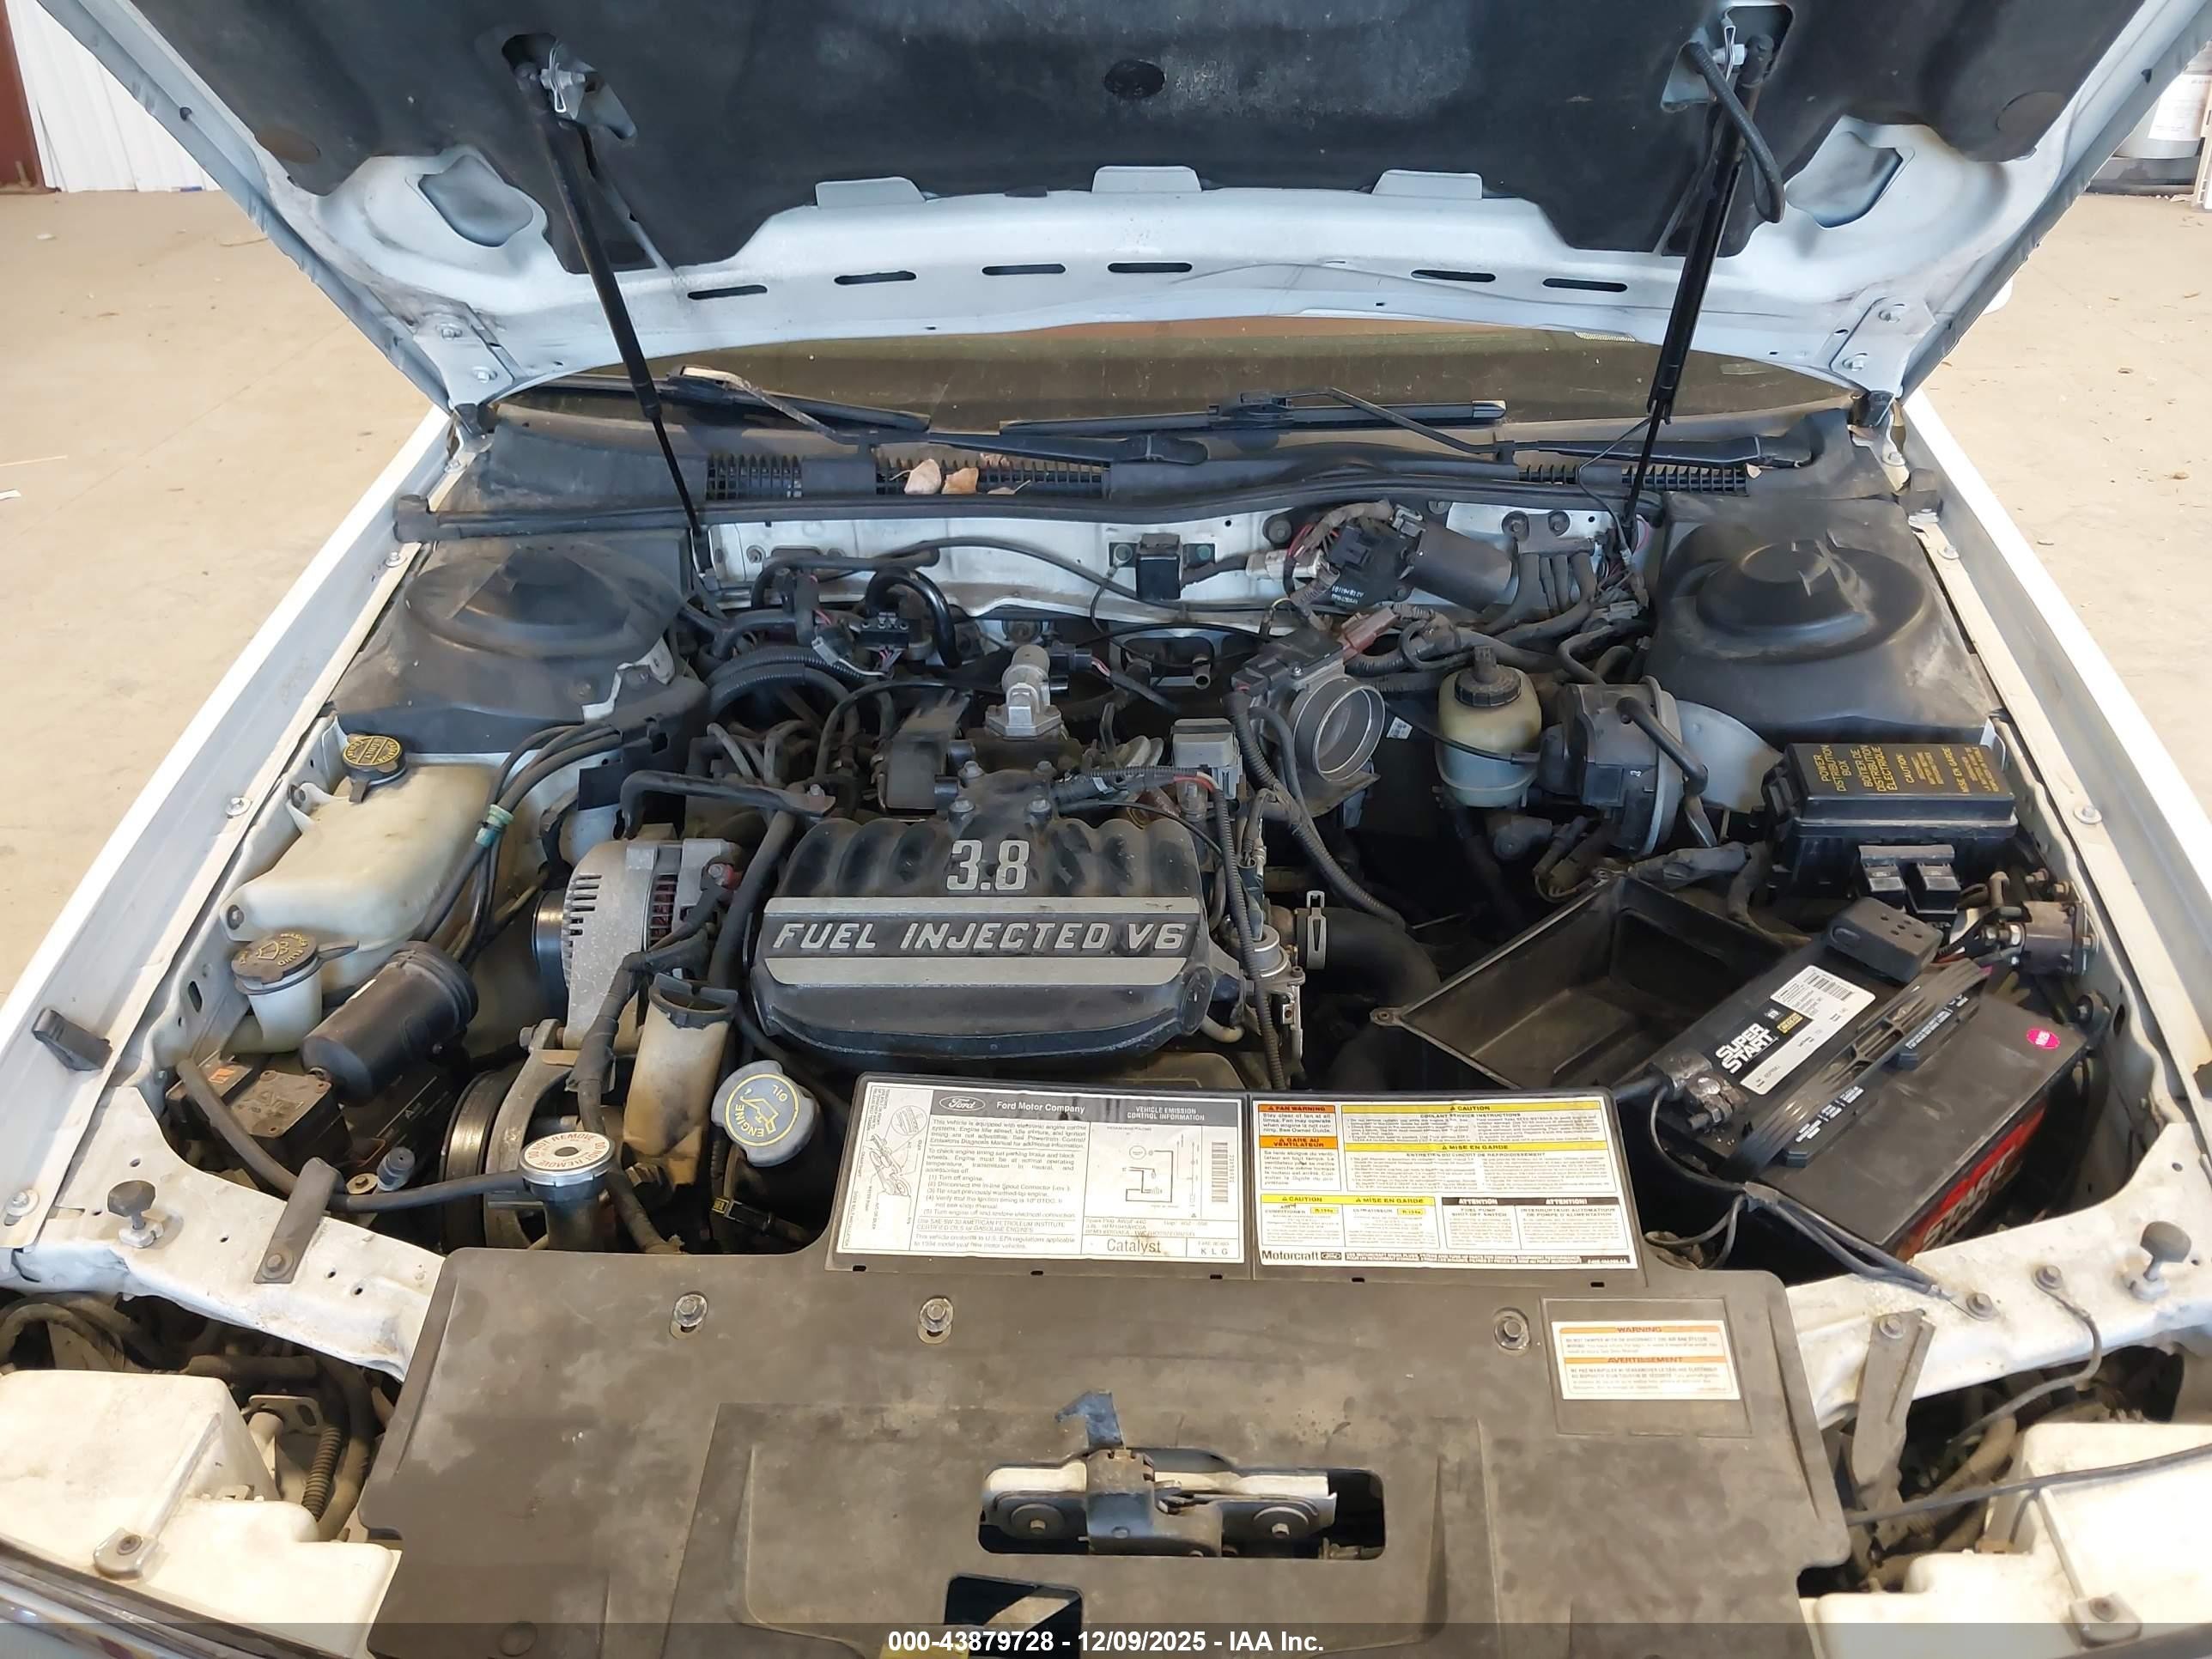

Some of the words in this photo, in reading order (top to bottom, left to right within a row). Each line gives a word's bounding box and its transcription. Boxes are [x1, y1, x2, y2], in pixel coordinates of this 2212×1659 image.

[1813, 754, 1832, 782] POWER
[1820, 744, 1847, 793] DISTRIBUTION
[1838, 759, 1852, 777] BOX
[1861, 744, 1887, 793] DISTRIBUTION
[945, 839, 1030, 891] 3.8
[772, 921, 878, 951] FUEL
[898, 921, 1112, 951] INJECTED
[1126, 921, 1189, 951] V6
[277, 948, 304, 967] FLUID
[1715, 1022, 1767, 1060] SUPER
[1721, 1028, 1776, 1075] START
[734, 1103, 764, 1139] ENGINE
[772, 1084, 789, 1103] OIL
[948, 1097, 976, 1110] Ford
[996, 1101, 1017, 1110] Ford
[1018, 1102, 1042, 1112] Motor
[1044, 1103, 1085, 1115] Company
[1135, 1105, 1163, 1114] VEHICLE
[1164, 1106, 1197, 1115] EMISSION
[1127, 1112, 1158, 1121] CONTROL
[1158, 1113, 1206, 1121] INFORMATION
[532, 1139, 550, 1152] NOT
[551, 1133, 597, 1143] REMOVE
[536, 1158, 584, 1169] REMOVE
[584, 1149, 604, 1163] NOT
[1106, 1237, 1162, 1255] Catalyst
[1261, 1249, 1319, 1261] Motorcraft
